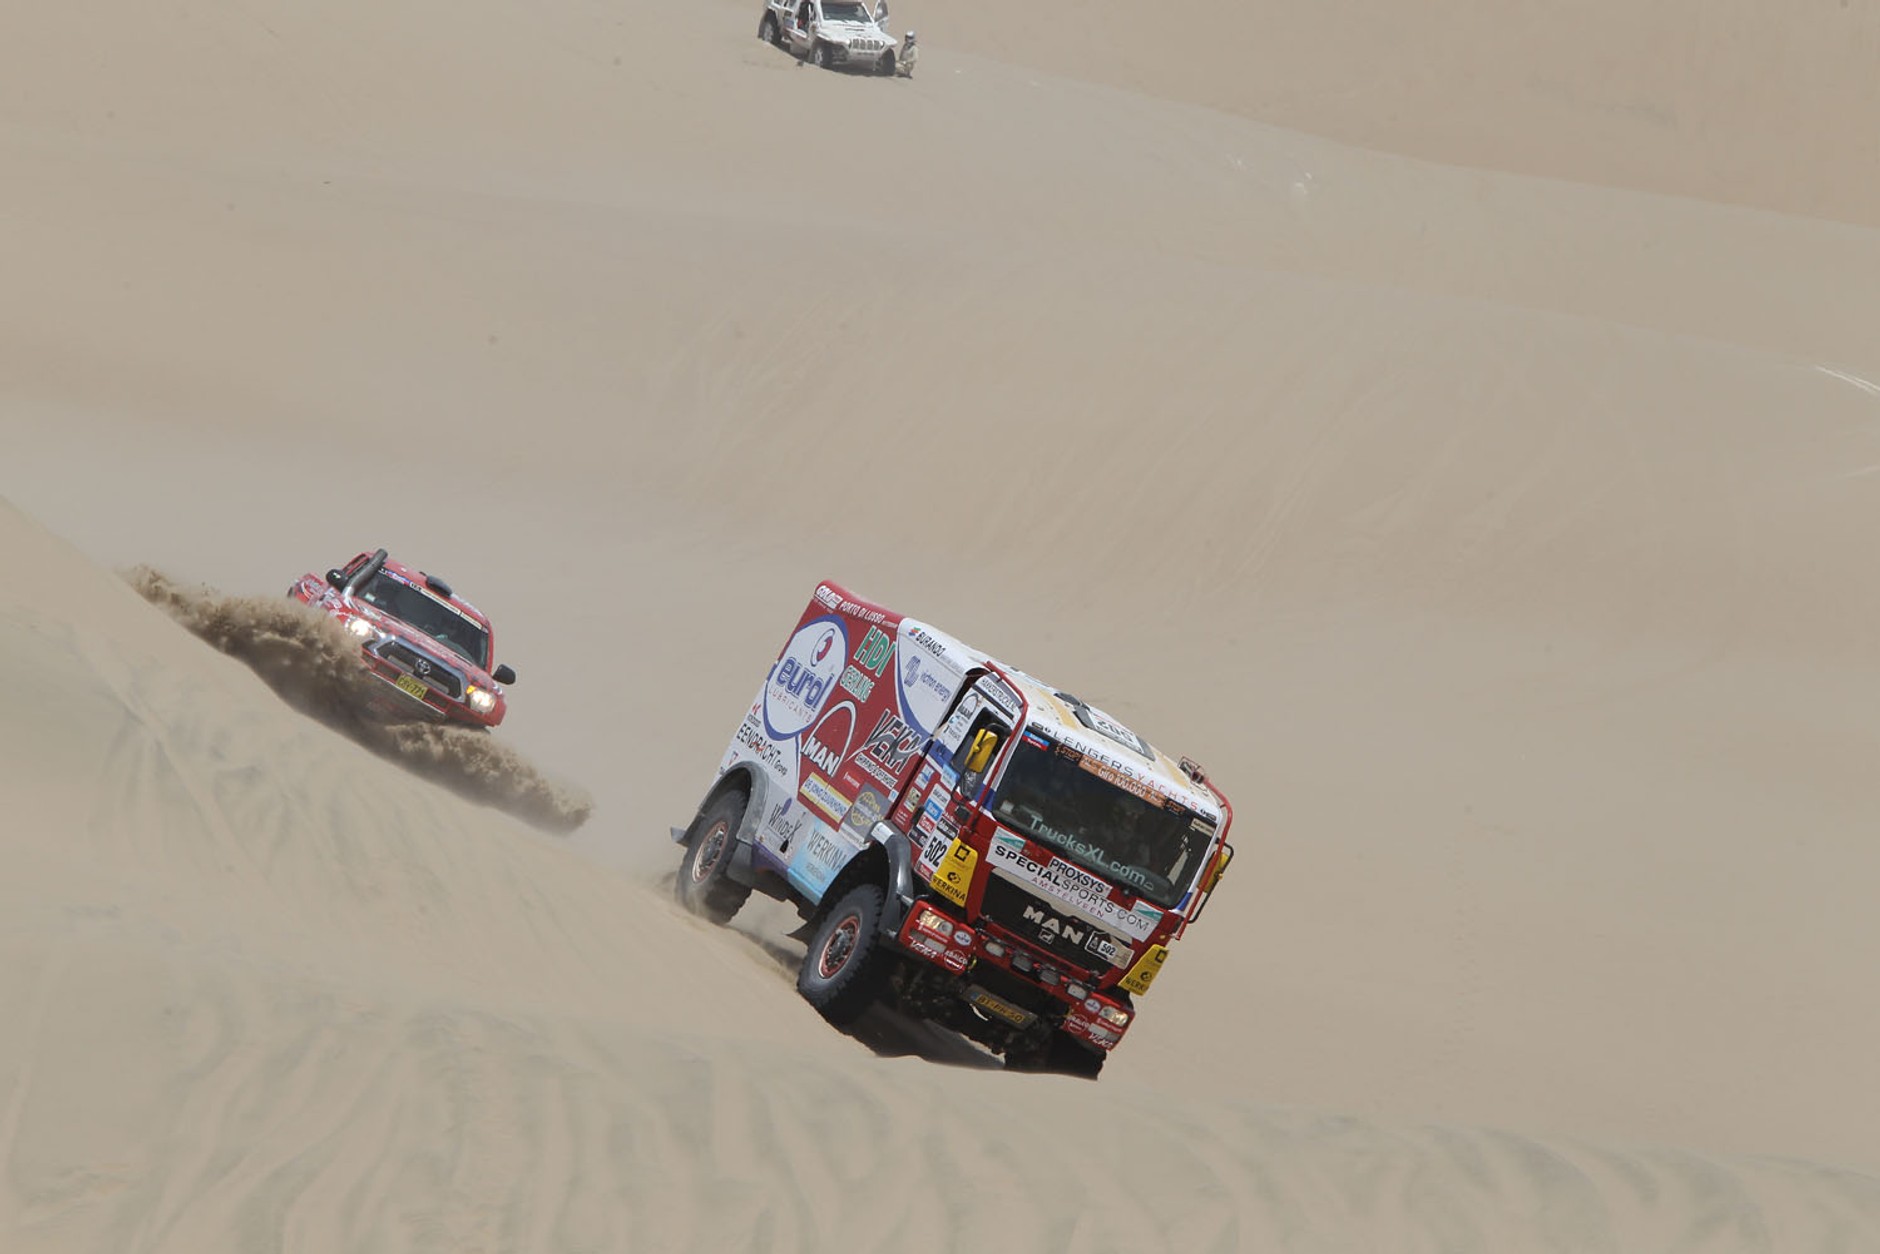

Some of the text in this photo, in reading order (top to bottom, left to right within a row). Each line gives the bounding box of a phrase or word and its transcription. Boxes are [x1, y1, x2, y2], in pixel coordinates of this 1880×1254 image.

[839, 601, 860, 617] PORTO
[853, 625, 896, 678] HDI
[769, 685, 813, 723] LUBRICANTS
[776, 657, 835, 712] eurol
[737, 723, 782, 766] EENDRACHT
[803, 735, 840, 776] MAN
[1053, 731, 1134, 777] LENGERS
[1138, 773, 1198, 811] YACHTS
[807, 827, 847, 871] WERKINA
[924, 836, 947, 867] 502
[1030, 814, 1146, 885] TrucksXL.com
[1050, 858, 1105, 893] PROXSYS
[1031, 876, 1105, 918] AMSTELVEEN
[1023, 905, 1084, 945] MAN
[1100, 943, 1116, 956] 502
